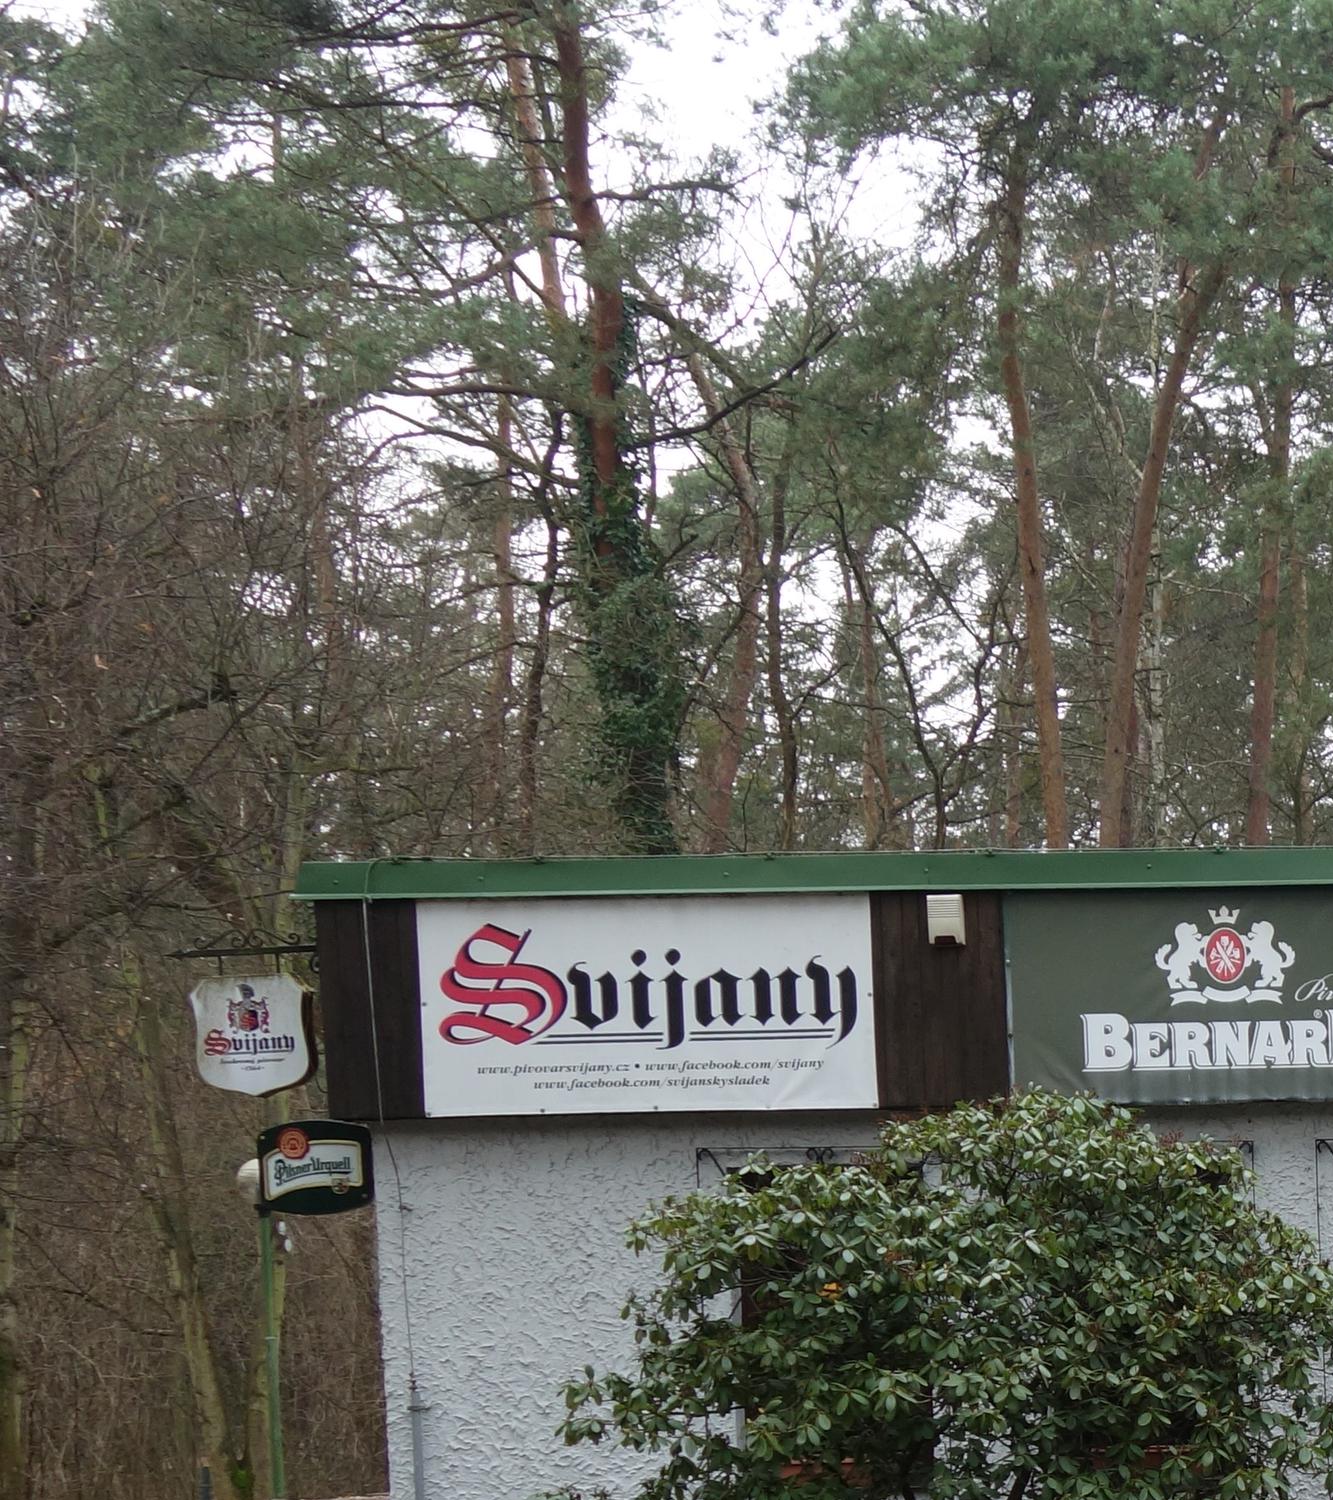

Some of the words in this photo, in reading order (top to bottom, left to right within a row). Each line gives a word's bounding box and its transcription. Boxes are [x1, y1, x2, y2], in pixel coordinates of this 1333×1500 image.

[438, 923, 858, 1049] Svijany
[204, 1028, 295, 1056] Svijany
[476, 1062, 630, 1076] www.pivovarsvijany.cz
[645, 1058, 825, 1073] www.facebook.com/svijany
[533, 1074, 771, 1091] www.facebook.com/svijanskysladek
[274, 1158, 312, 1186] Pilsner
[311, 1157, 351, 1176] Urquell
